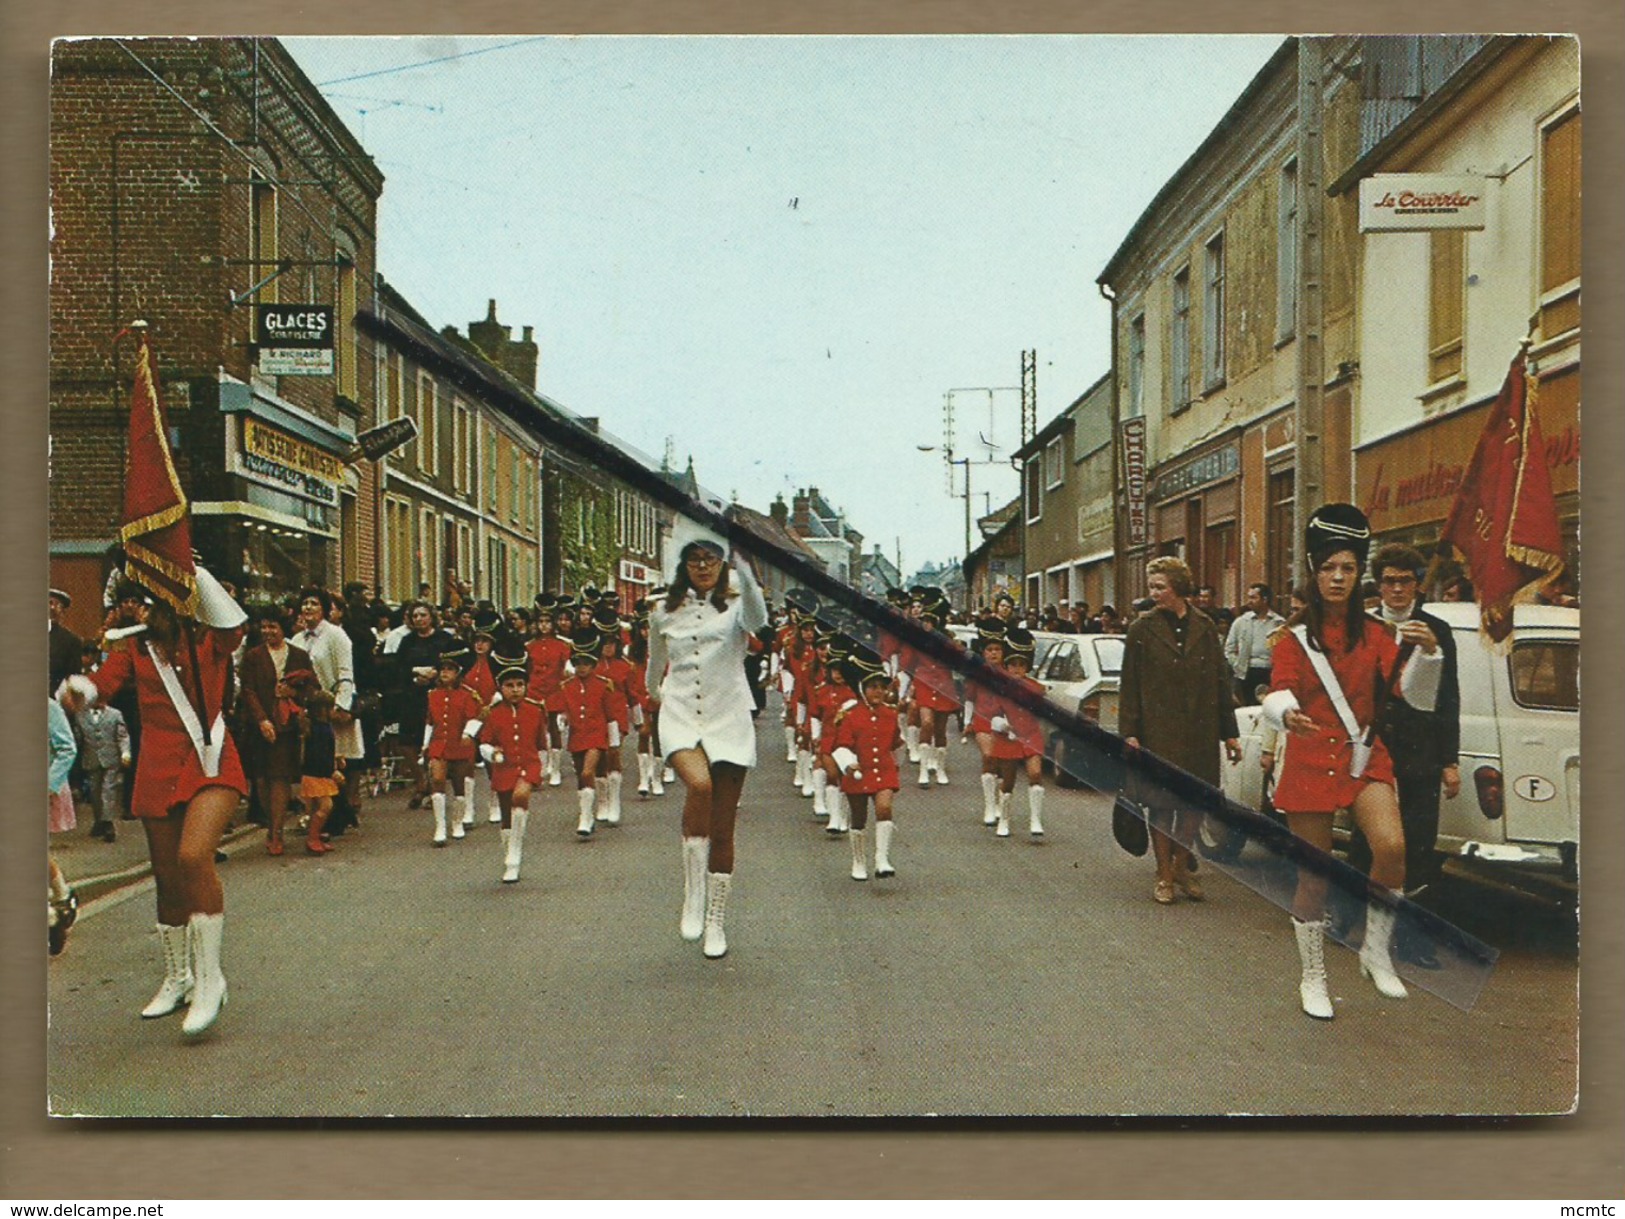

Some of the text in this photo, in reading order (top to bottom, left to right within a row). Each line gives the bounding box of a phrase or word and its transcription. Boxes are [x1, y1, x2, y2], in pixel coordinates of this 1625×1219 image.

[1374, 190, 1479, 208] Le Courrier
[265, 312, 327, 331] GLACES
[1530, 779, 1540, 797] F
